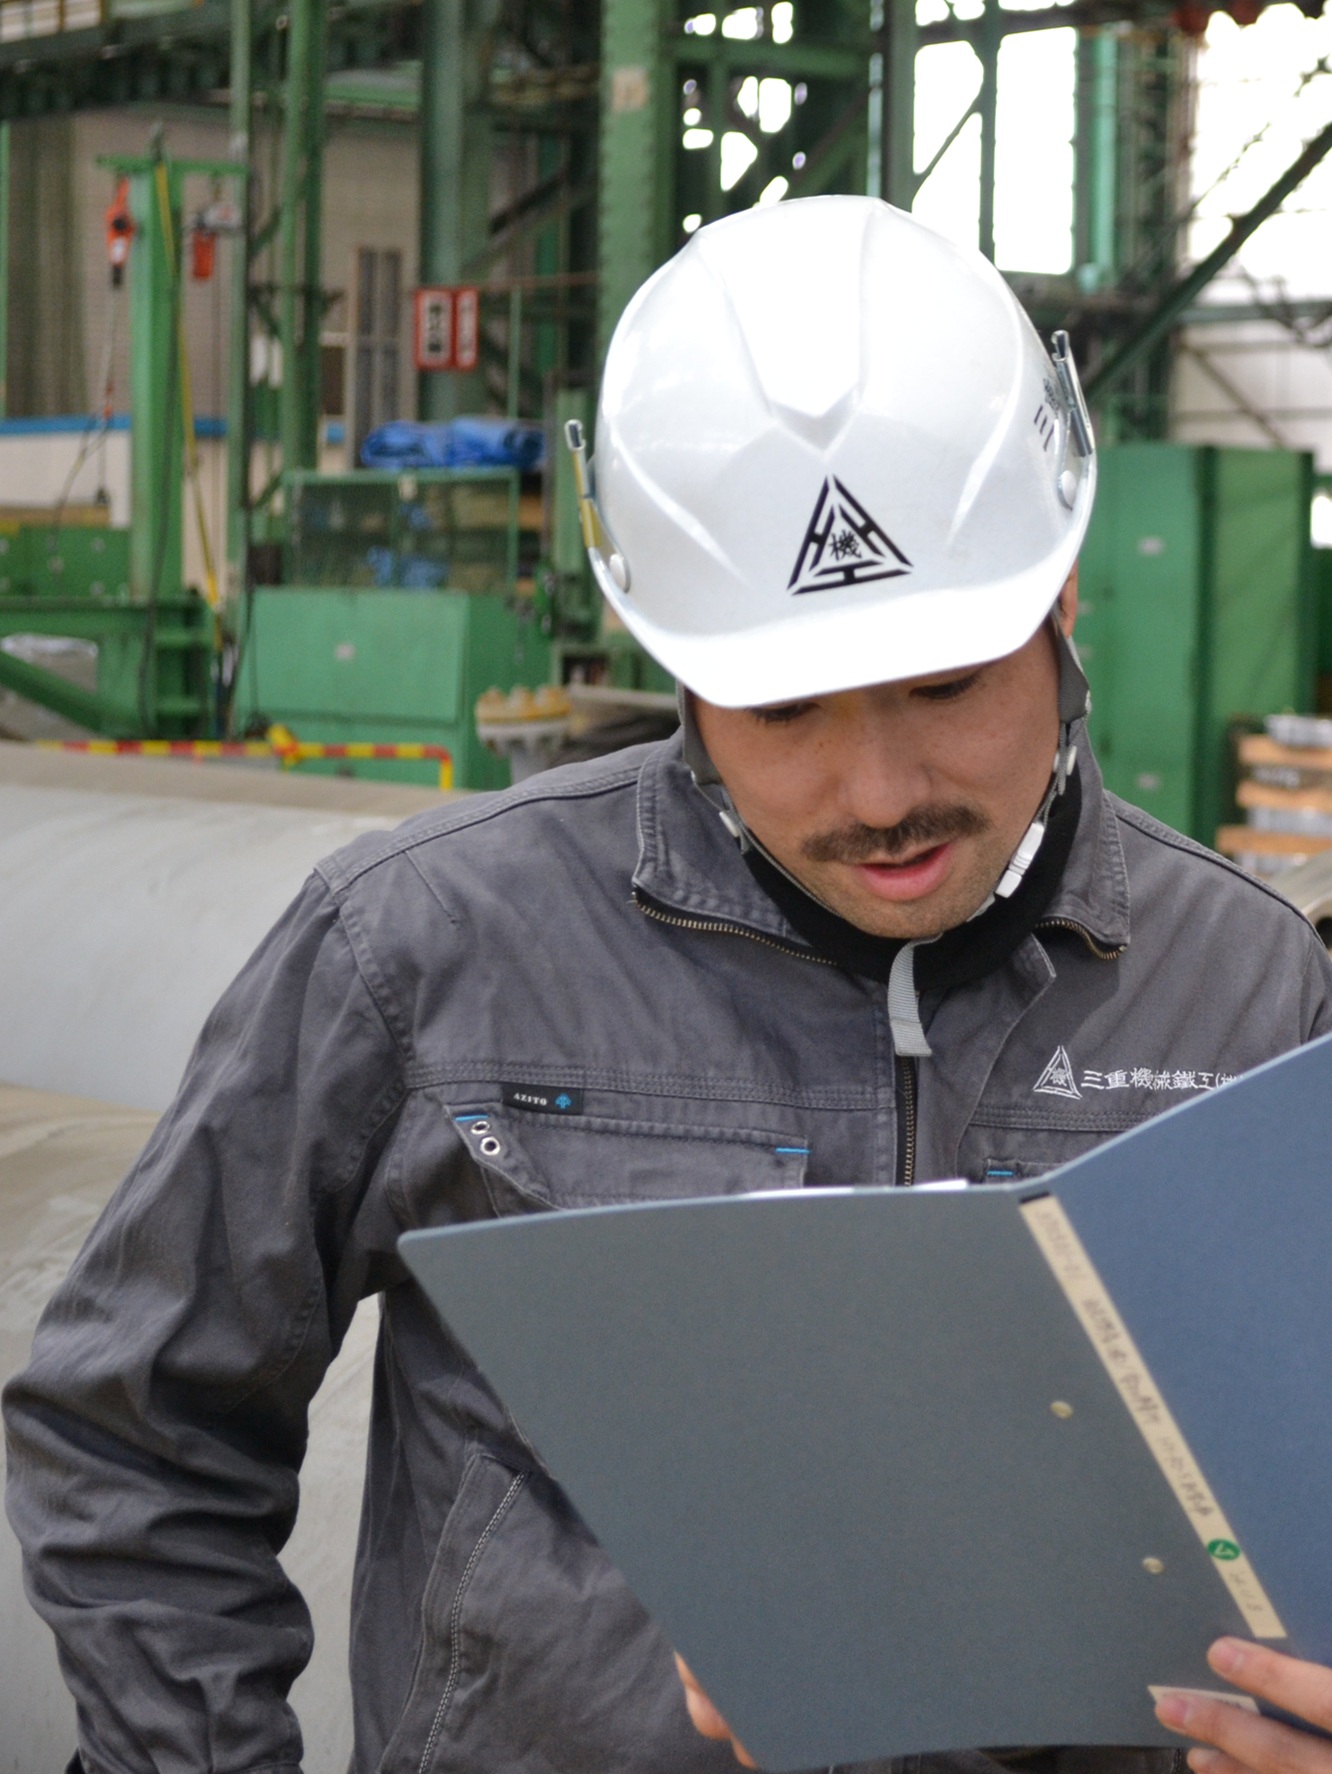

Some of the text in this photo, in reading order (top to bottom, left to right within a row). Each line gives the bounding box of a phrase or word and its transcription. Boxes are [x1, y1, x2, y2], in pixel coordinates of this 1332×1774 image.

[1081, 1067, 1243, 1091] 三重機械鐵工(
[514, 1092, 548, 1106] AZITO
